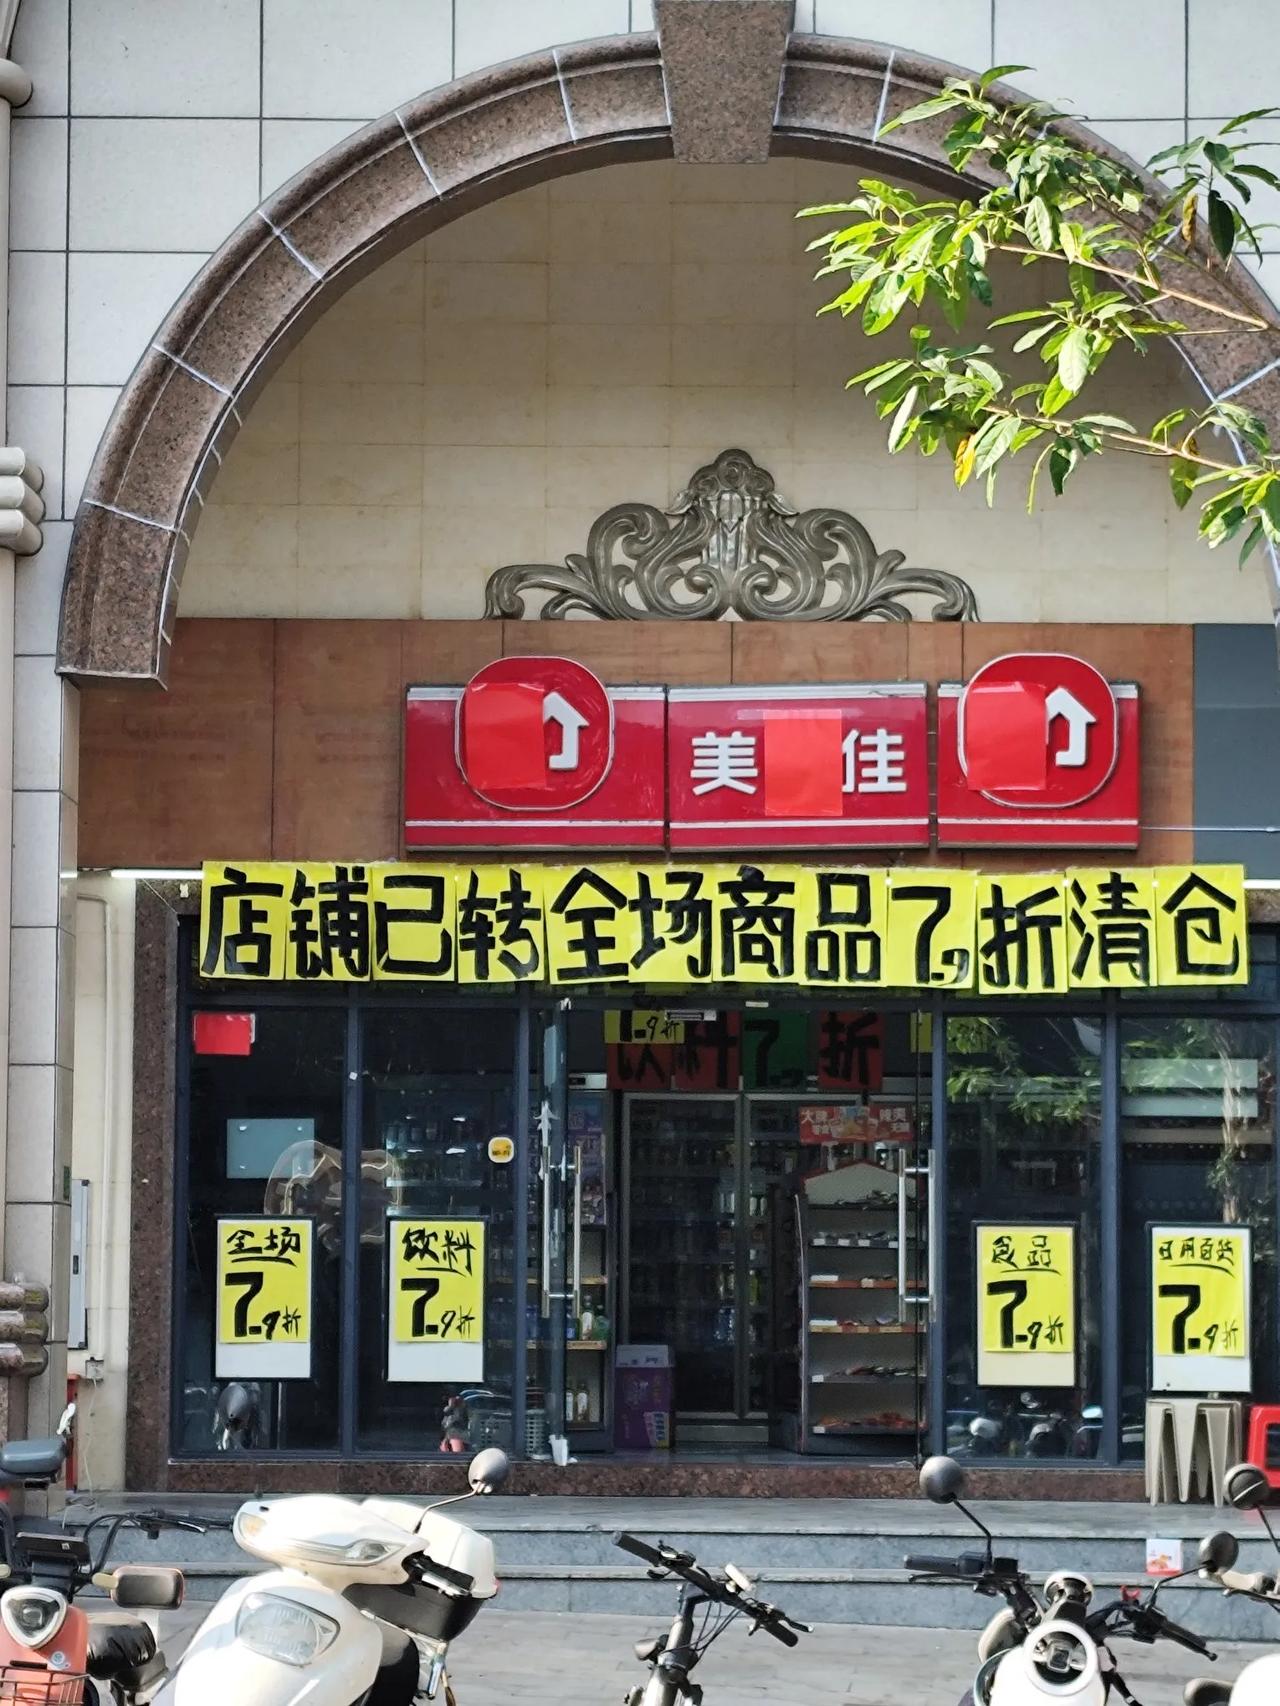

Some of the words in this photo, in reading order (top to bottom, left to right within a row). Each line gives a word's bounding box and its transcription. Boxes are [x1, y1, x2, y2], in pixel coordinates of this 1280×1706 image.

[690, 728, 907, 796] 美佳
[226, 1226, 301, 1256] 全场
[401, 1227, 477, 1276] 饮料
[991, 1235, 1052, 1269] 食品
[1158, 1236, 1235, 1266] 日用百货
[225, 1271, 302, 1340] 7.9折
[400, 1277, 476, 1338] 7.9折
[986, 1279, 1064, 1350] 7.9折
[1158, 1283, 1239, 1355] 7.9折
